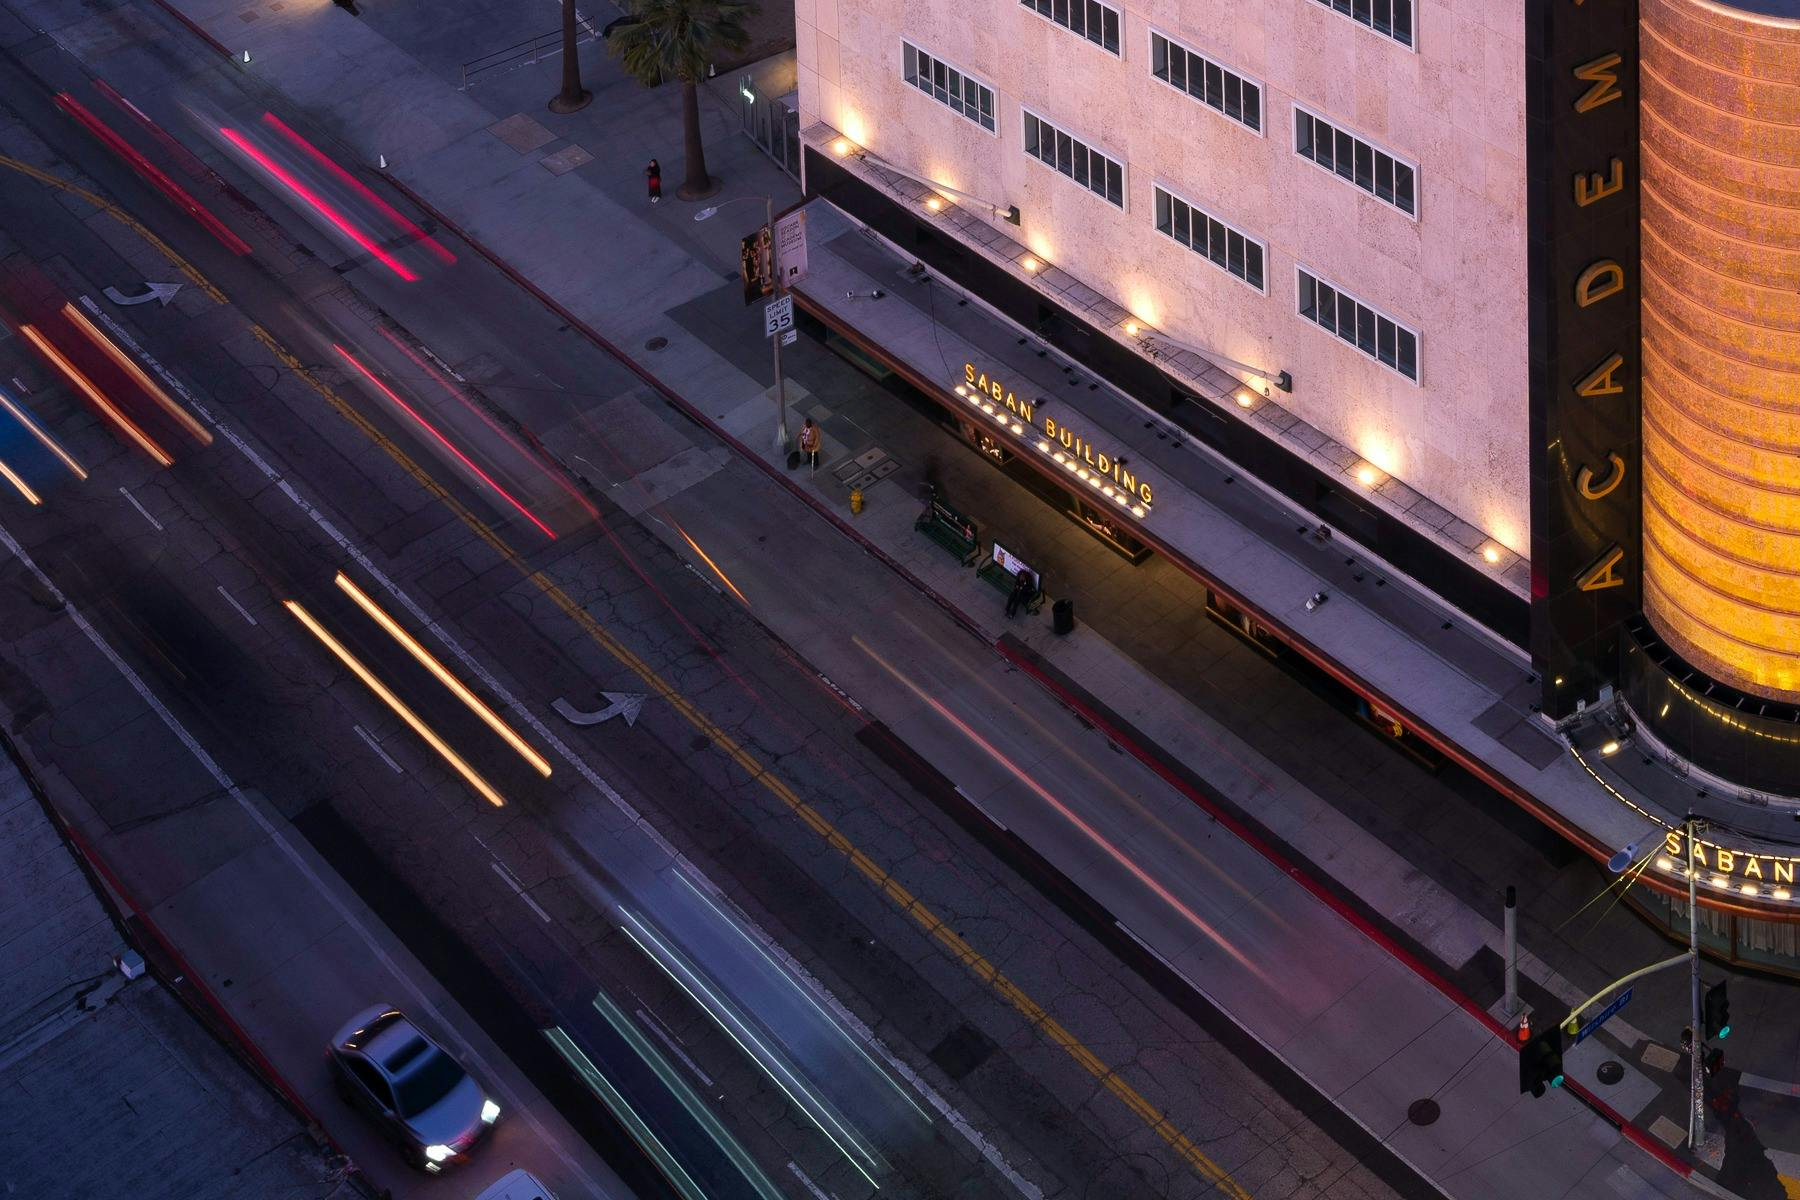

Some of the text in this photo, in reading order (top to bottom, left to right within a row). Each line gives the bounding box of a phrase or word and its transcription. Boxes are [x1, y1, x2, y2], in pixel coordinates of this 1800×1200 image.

[767, 297, 791, 313] SPEED
[769, 305, 788, 319] LIMIT
[769, 312, 791, 332] 35
[965, 363, 1152, 503] SABAN BUILDING
[1665, 831, 1794, 884] SABAN
